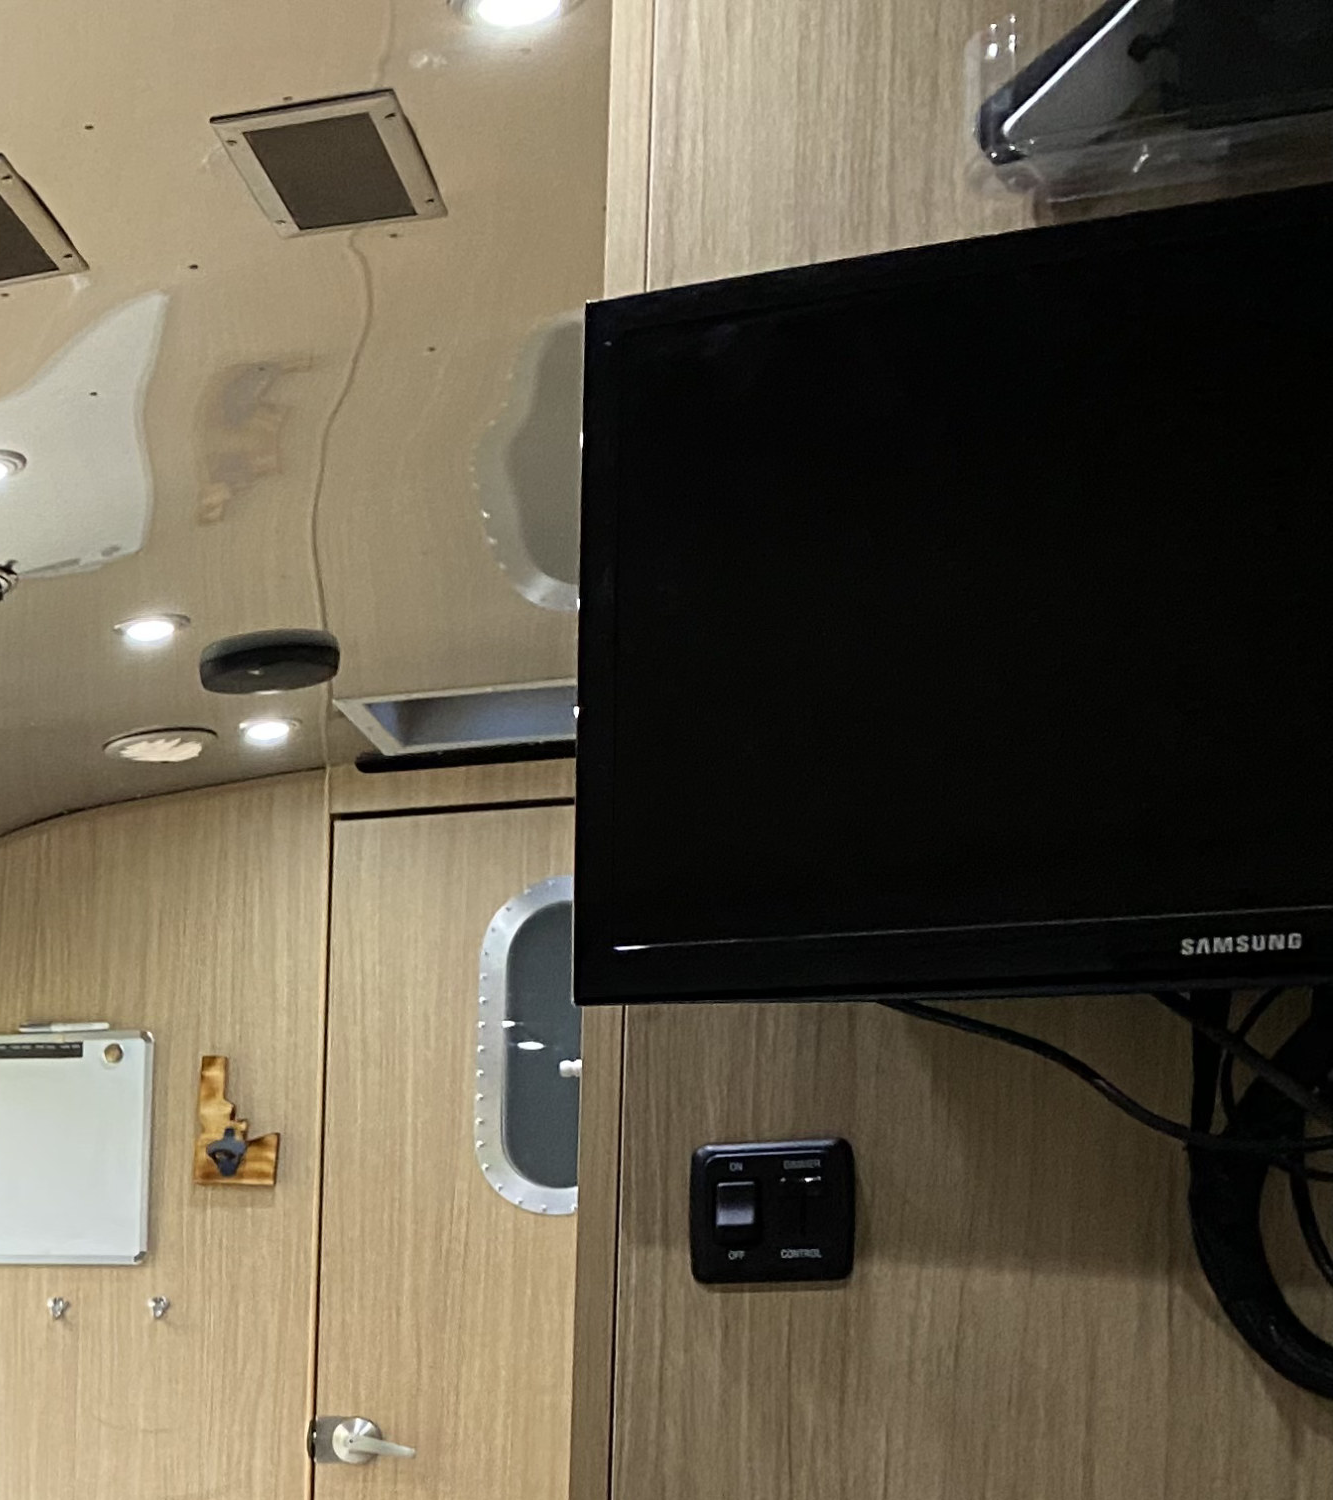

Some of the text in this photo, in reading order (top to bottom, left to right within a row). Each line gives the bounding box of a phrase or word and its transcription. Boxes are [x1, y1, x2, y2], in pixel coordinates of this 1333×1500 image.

[1180, 933, 1302, 956] SAMSUNG
[730, 1162, 743, 1172] ON
[728, 1250, 745, 1260] OFF
